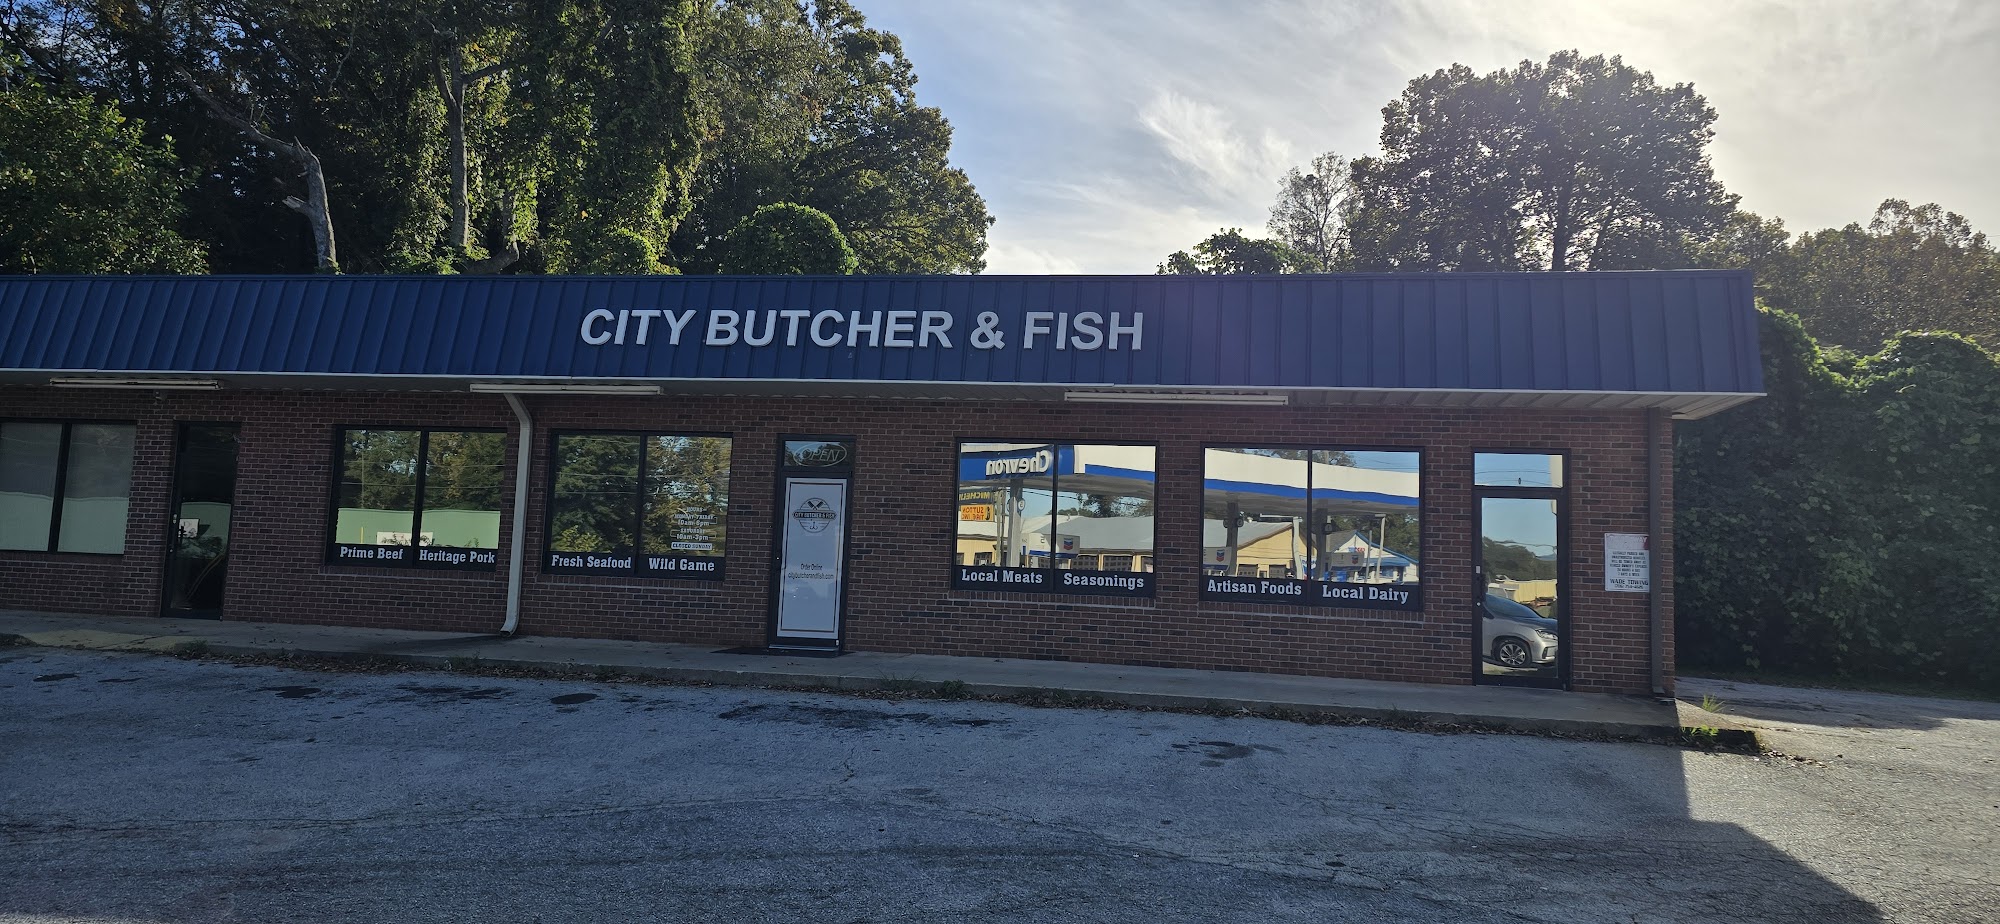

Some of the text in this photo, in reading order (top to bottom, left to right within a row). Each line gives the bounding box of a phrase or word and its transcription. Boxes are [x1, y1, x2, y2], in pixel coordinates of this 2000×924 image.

[580, 308, 1144, 350] CITY BUTCHER & FISH
[801, 447, 842, 462] OPEN
[340, 546, 404, 560] Prime Beef
[419, 549, 496, 565] Heritage Pork
[551, 554, 632, 569] Fresh Seafood
[648, 557, 715, 572] Wild Game
[961, 569, 1043, 584] Local Meats
[1063, 572, 1145, 590] Seasonings
[1207, 579, 1302, 595] Artisan Foods
[1322, 584, 1409, 605] Local Dairy
